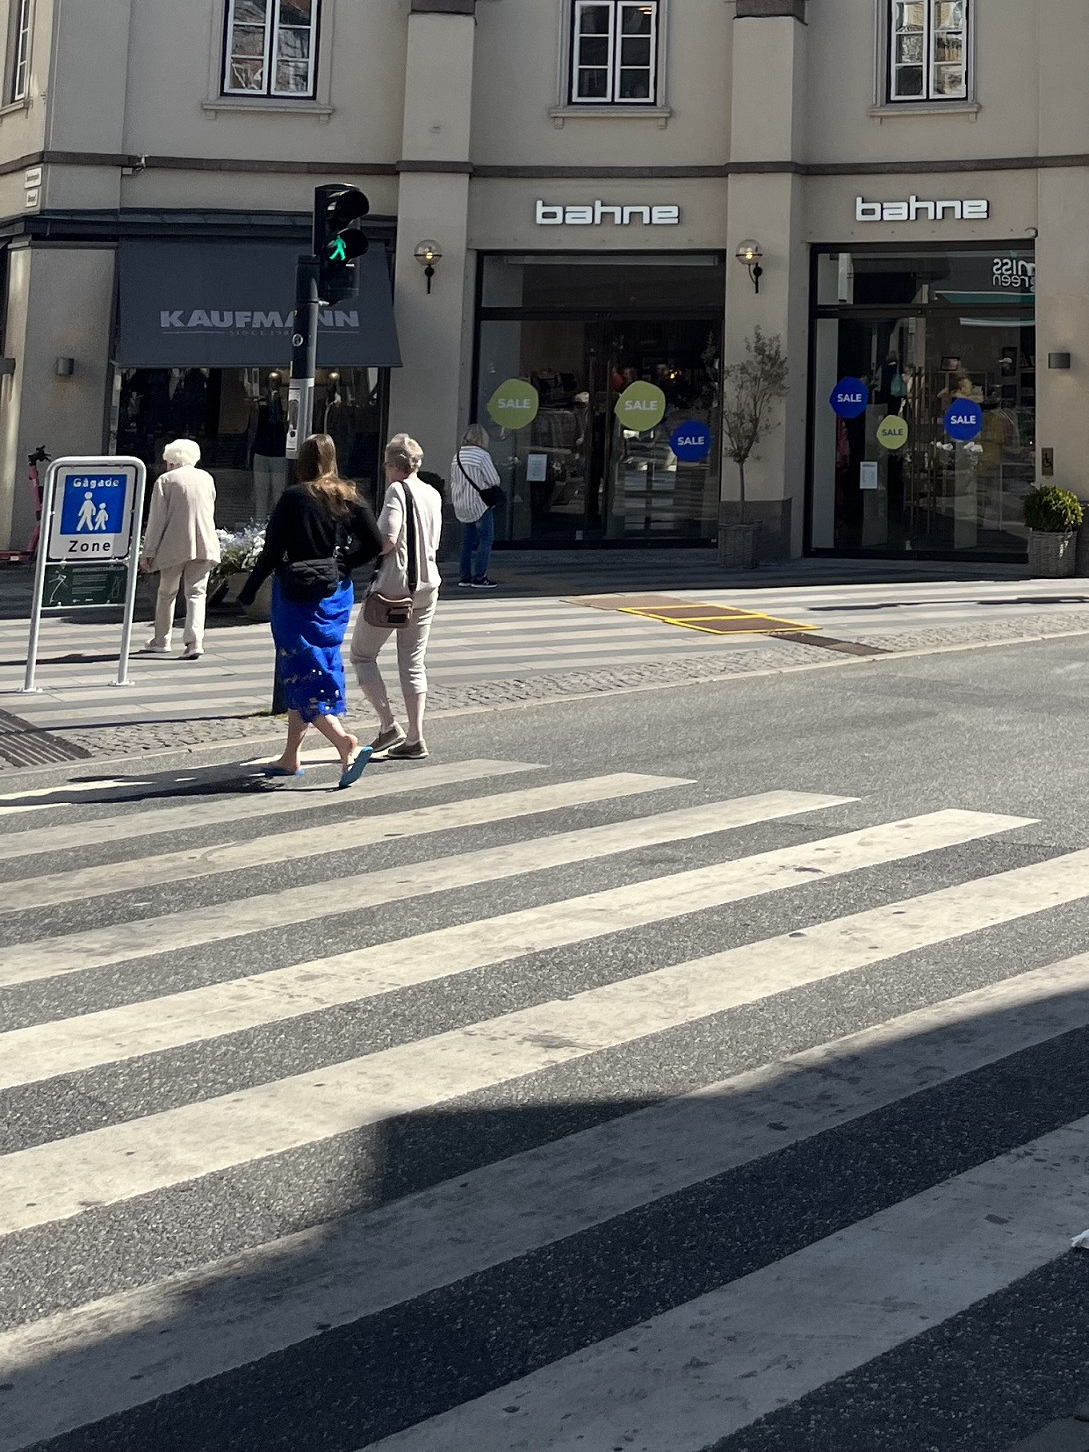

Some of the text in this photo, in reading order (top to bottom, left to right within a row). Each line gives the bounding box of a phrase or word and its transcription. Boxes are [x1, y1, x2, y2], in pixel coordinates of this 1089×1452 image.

[535, 199, 680, 225] bahne
[856, 195, 989, 222] bahne
[837, 393, 862, 402] SALE
[497, 398, 531, 409] SALE
[624, 400, 657, 410] SALE
[950, 415, 976, 424] SALE
[677, 436, 705, 445] SALE
[73, 478, 120, 488] Gågade
[68, 540, 111, 553] Zone
